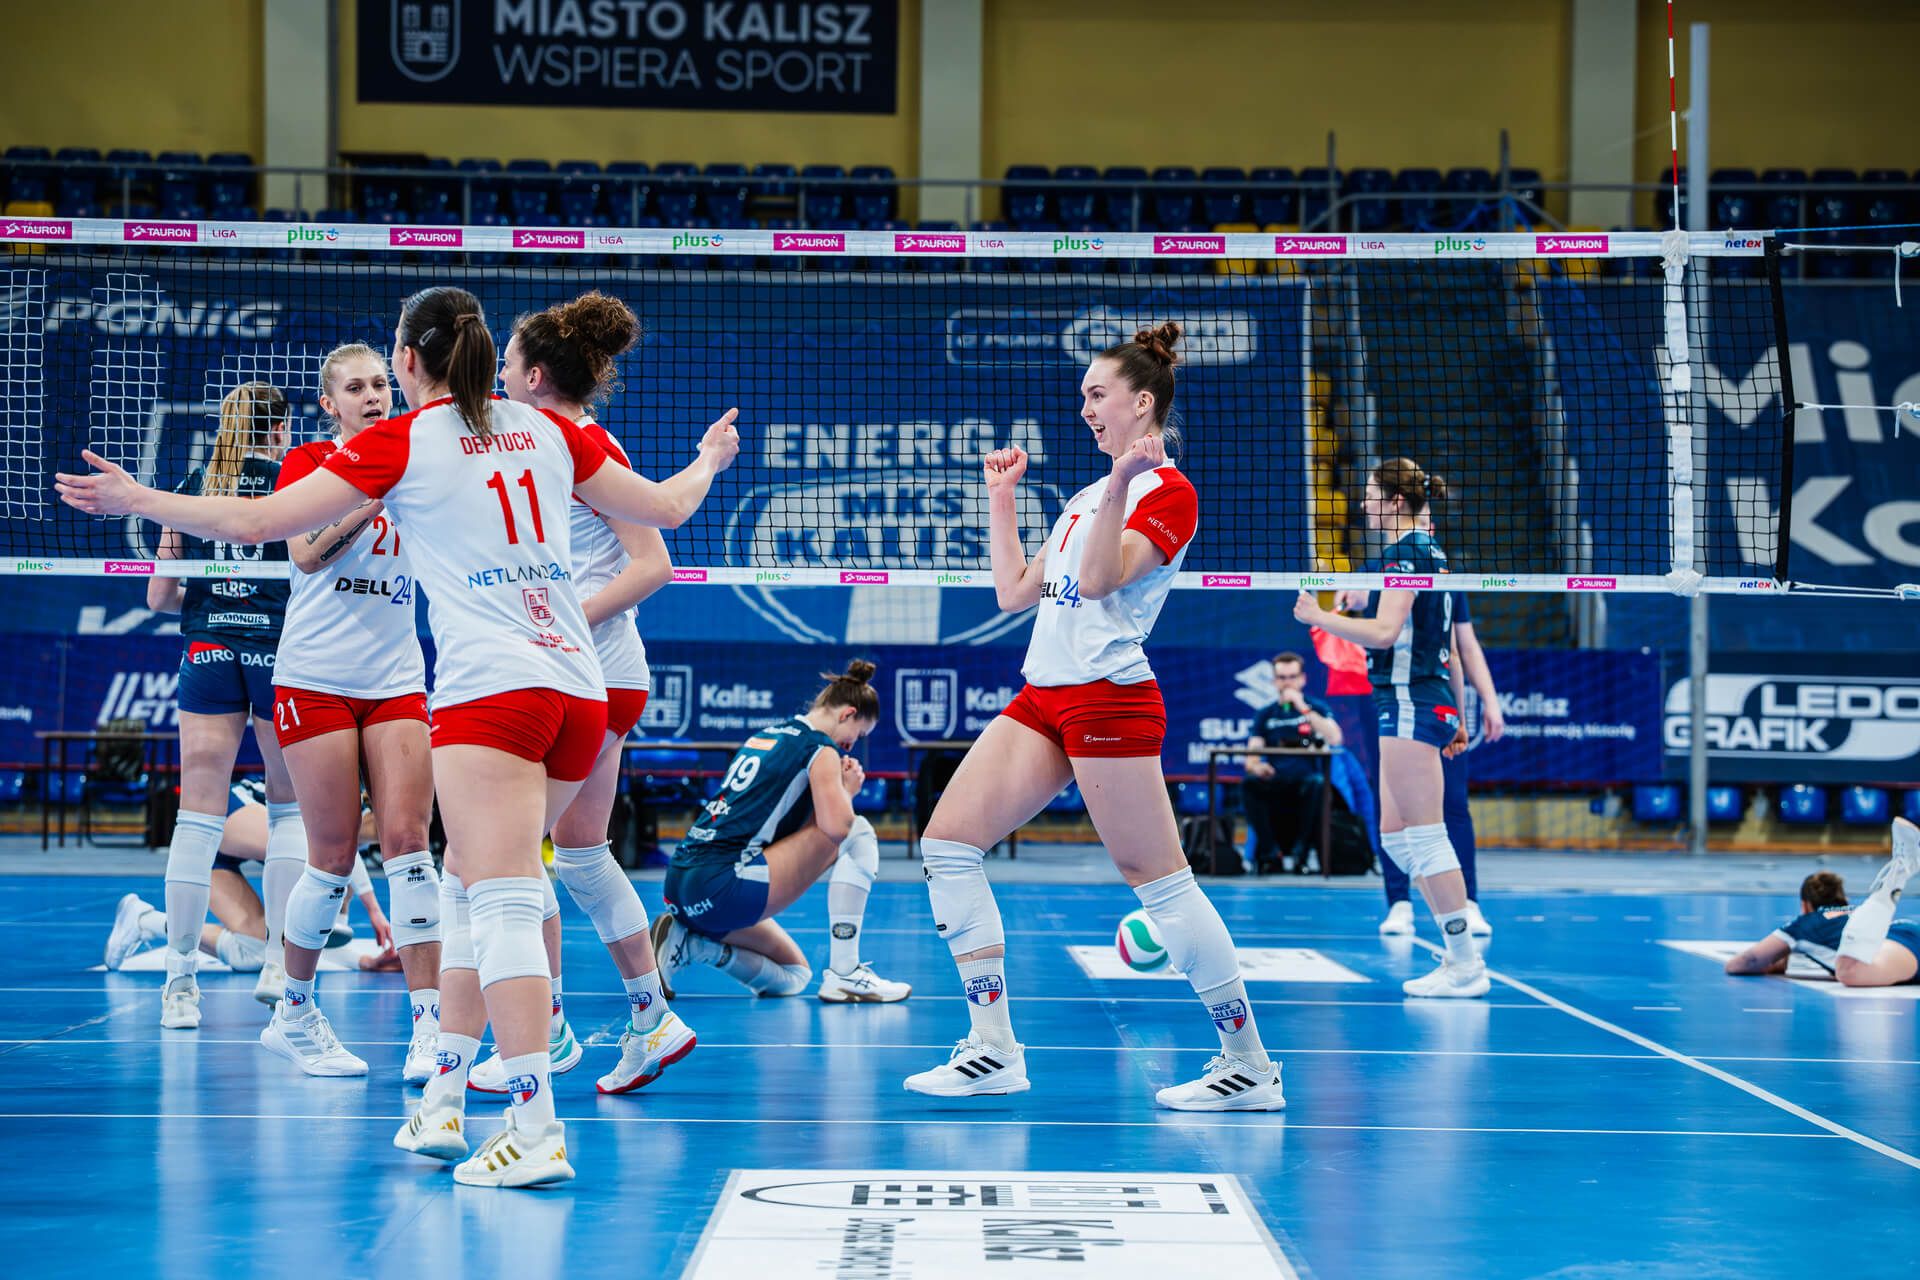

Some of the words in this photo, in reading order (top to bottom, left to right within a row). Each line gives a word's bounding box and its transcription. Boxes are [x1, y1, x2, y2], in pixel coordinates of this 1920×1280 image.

[494, 0, 687, 39] MIASTO
[705, 2, 872, 44] KALISZ
[494, 45, 701, 88] WSPIERA
[715, 50, 873, 93] SPORT
[22, 225, 66, 235] TAURON
[147, 227, 192, 237] TAURON
[212, 229, 237, 239] LIGA
[287, 226, 324, 244] plus
[412, 233, 457, 243] TAURON
[535, 235, 579, 245] TAURON
[599, 236, 624, 246] LIGA
[672, 233, 709, 250] plus
[795, 238, 839, 247] TAURON
[916, 239, 960, 248] TAURON
[980, 239, 1005, 248] LIGA
[1053, 236, 1089, 253] plus
[1176, 240, 1219, 250] TAURON
[1298, 241, 1341, 250] TAURON
[1361, 240, 1385, 250] LIGA
[1434, 238, 1471, 254] plus
[1559, 239, 1602, 249] TAURON
[1725, 239, 1762, 250] netex
[460, 431, 537, 455] DEPTUCH
[764, 418, 1047, 469] ENERGA
[486, 469, 545, 545] 11
[840, 487, 967, 521] MKS
[1147, 515, 1178, 545] NETLAND
[775, 525, 1031, 562] KALIS
[118, 564, 151, 573] TAURON
[855, 574, 886, 583] TAURON
[1216, 577, 1248, 586] TAURON
[1399, 578, 1431, 587] TAURON
[1582, 579, 1613, 588] TAURON
[1739, 580, 1771, 589] netex
[193, 648, 235, 665] EURO
[241, 652, 275, 667] DAC
[277, 697, 301, 732] 21
[1663, 716, 1830, 752] GRAFIK
[721, 754, 761, 792] 19
[971, 977, 990, 986] MKS
[967, 981, 1000, 993] KALISZ
